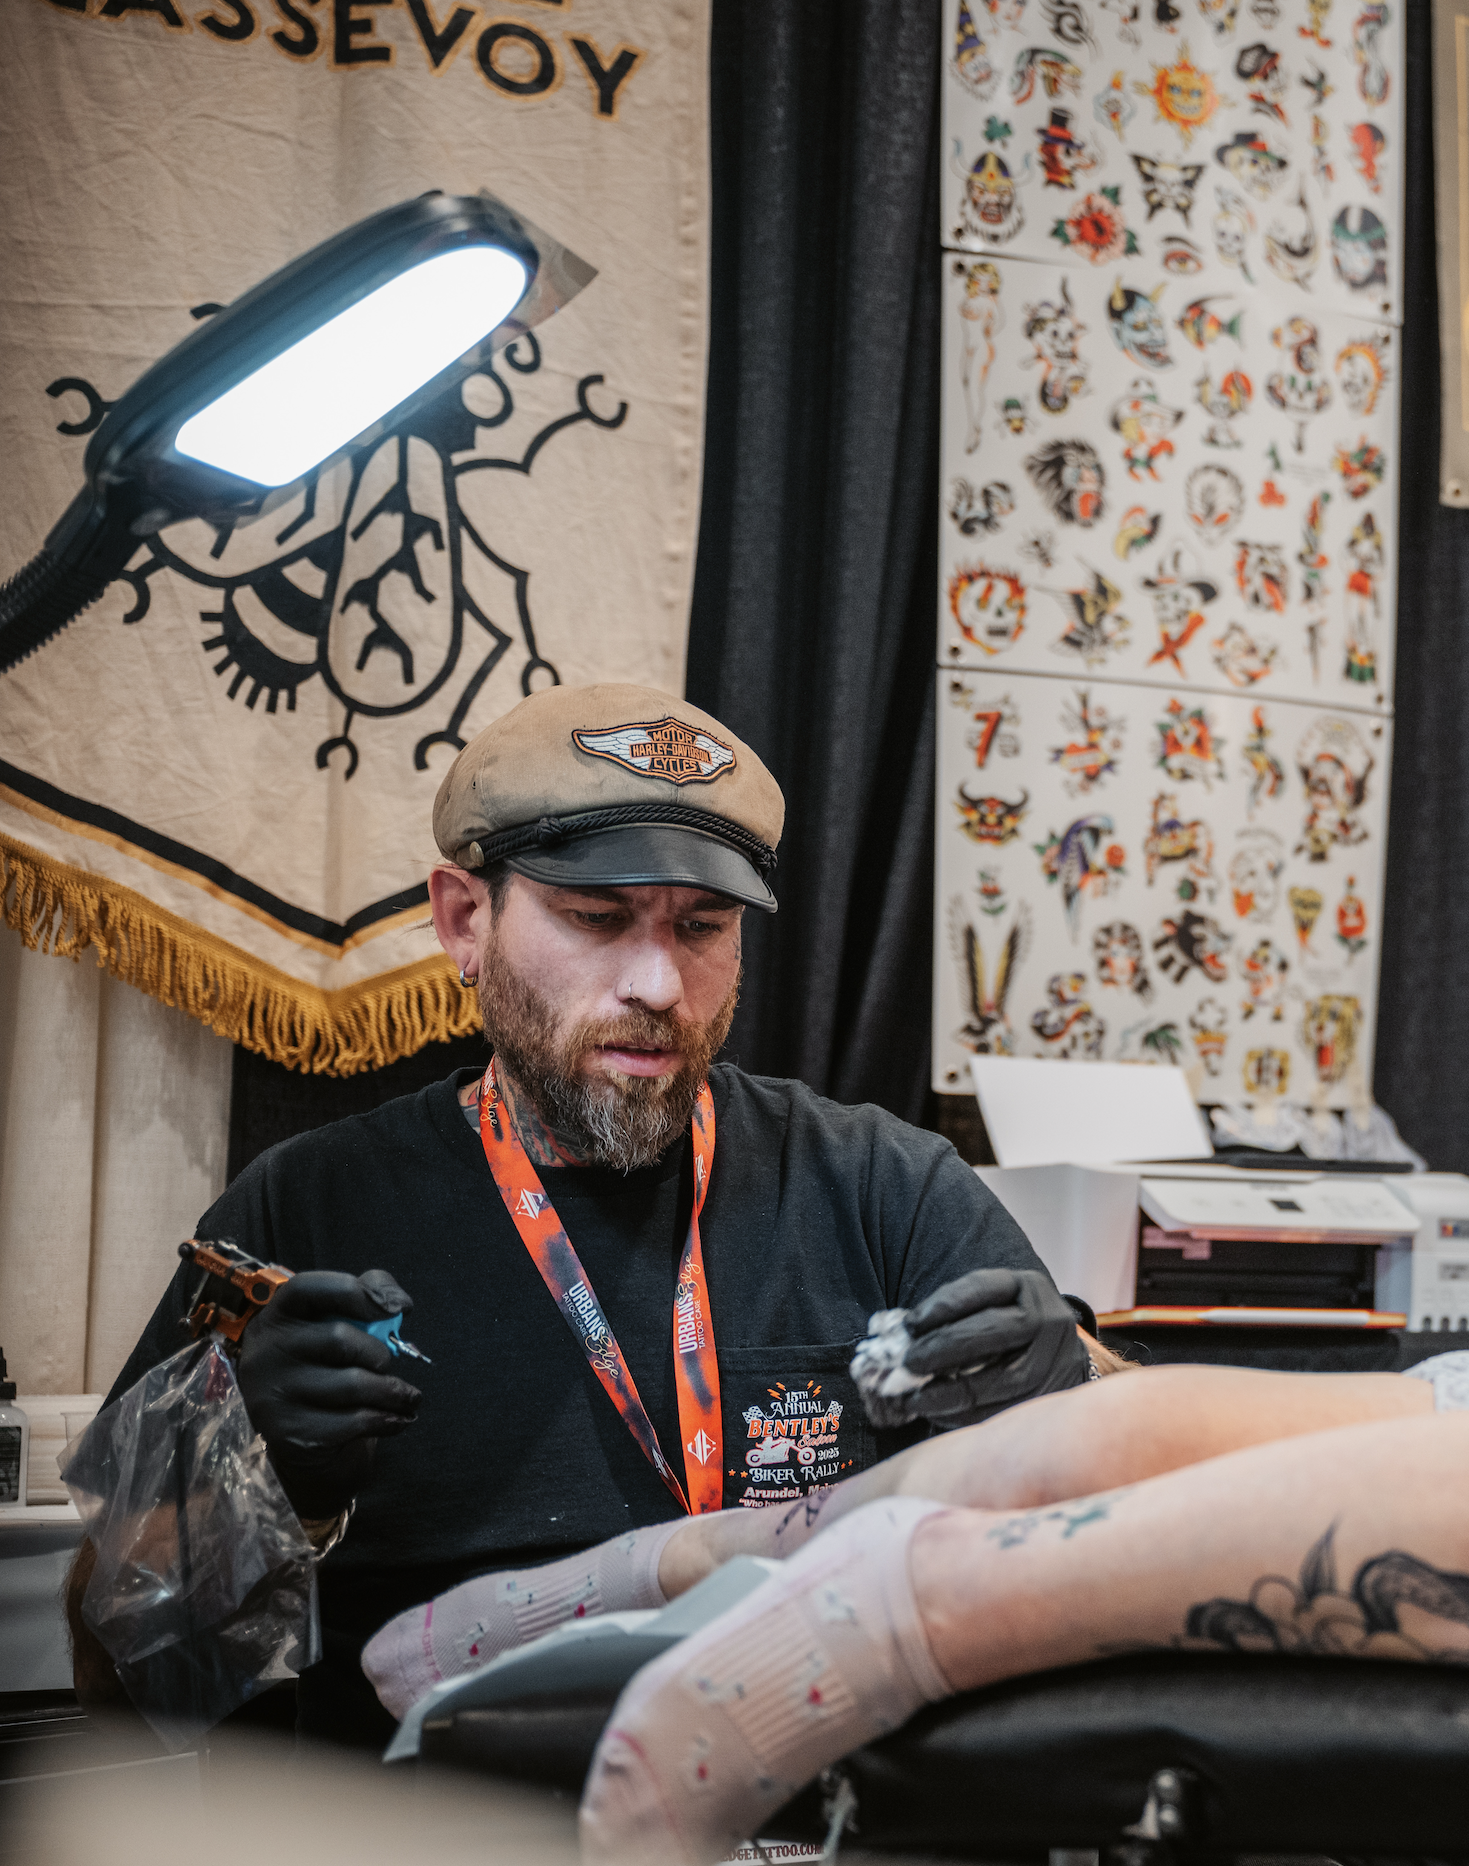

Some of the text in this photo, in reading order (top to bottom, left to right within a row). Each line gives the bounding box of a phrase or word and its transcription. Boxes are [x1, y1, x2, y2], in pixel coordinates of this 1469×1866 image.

[50, 0, 638, 116] SSEVOY
[652, 727, 693, 745] MOTOR
[632, 743, 709, 763] HARLEY-DAVIDSON
[653, 758, 698, 775] CYCLES
[561, 1291, 588, 1338] TATTOO CARE
[694, 1299, 706, 1349] TATTOO CARE
[766, 1400, 825, 1419] ANNUAL
[747, 1413, 840, 1438] BENTLEY'S
[817, 1447, 840, 1461] 2025
[748, 1462, 840, 1485] BIKER RALLY
[743, 1486, 803, 1499] Arundel,
